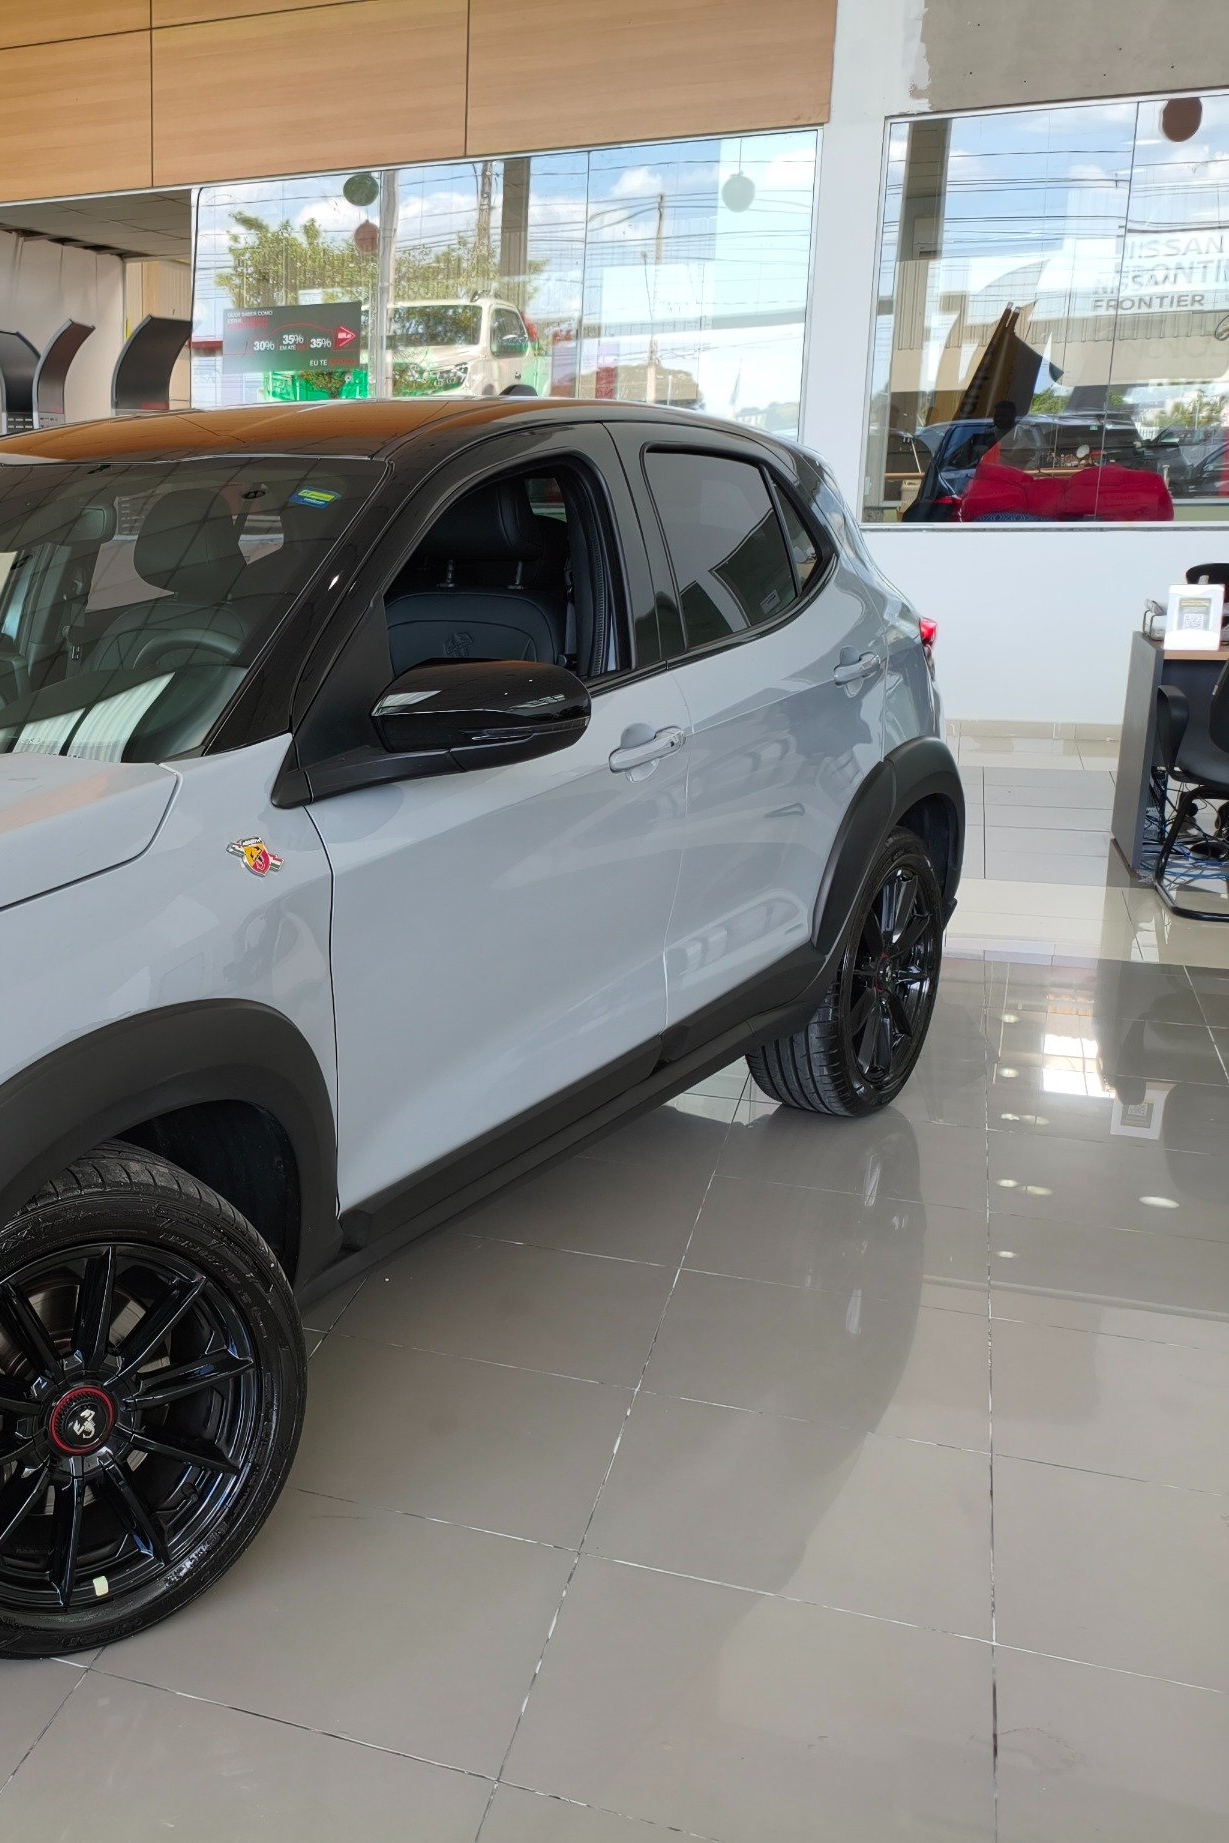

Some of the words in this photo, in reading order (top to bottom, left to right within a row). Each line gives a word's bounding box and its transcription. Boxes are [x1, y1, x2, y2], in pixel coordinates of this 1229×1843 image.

[1093, 294, 1205, 313] FRONTIER
[282, 334, 304, 345] 35%
[310, 338, 332, 348] 35%
[253, 341, 275, 351] 30%
